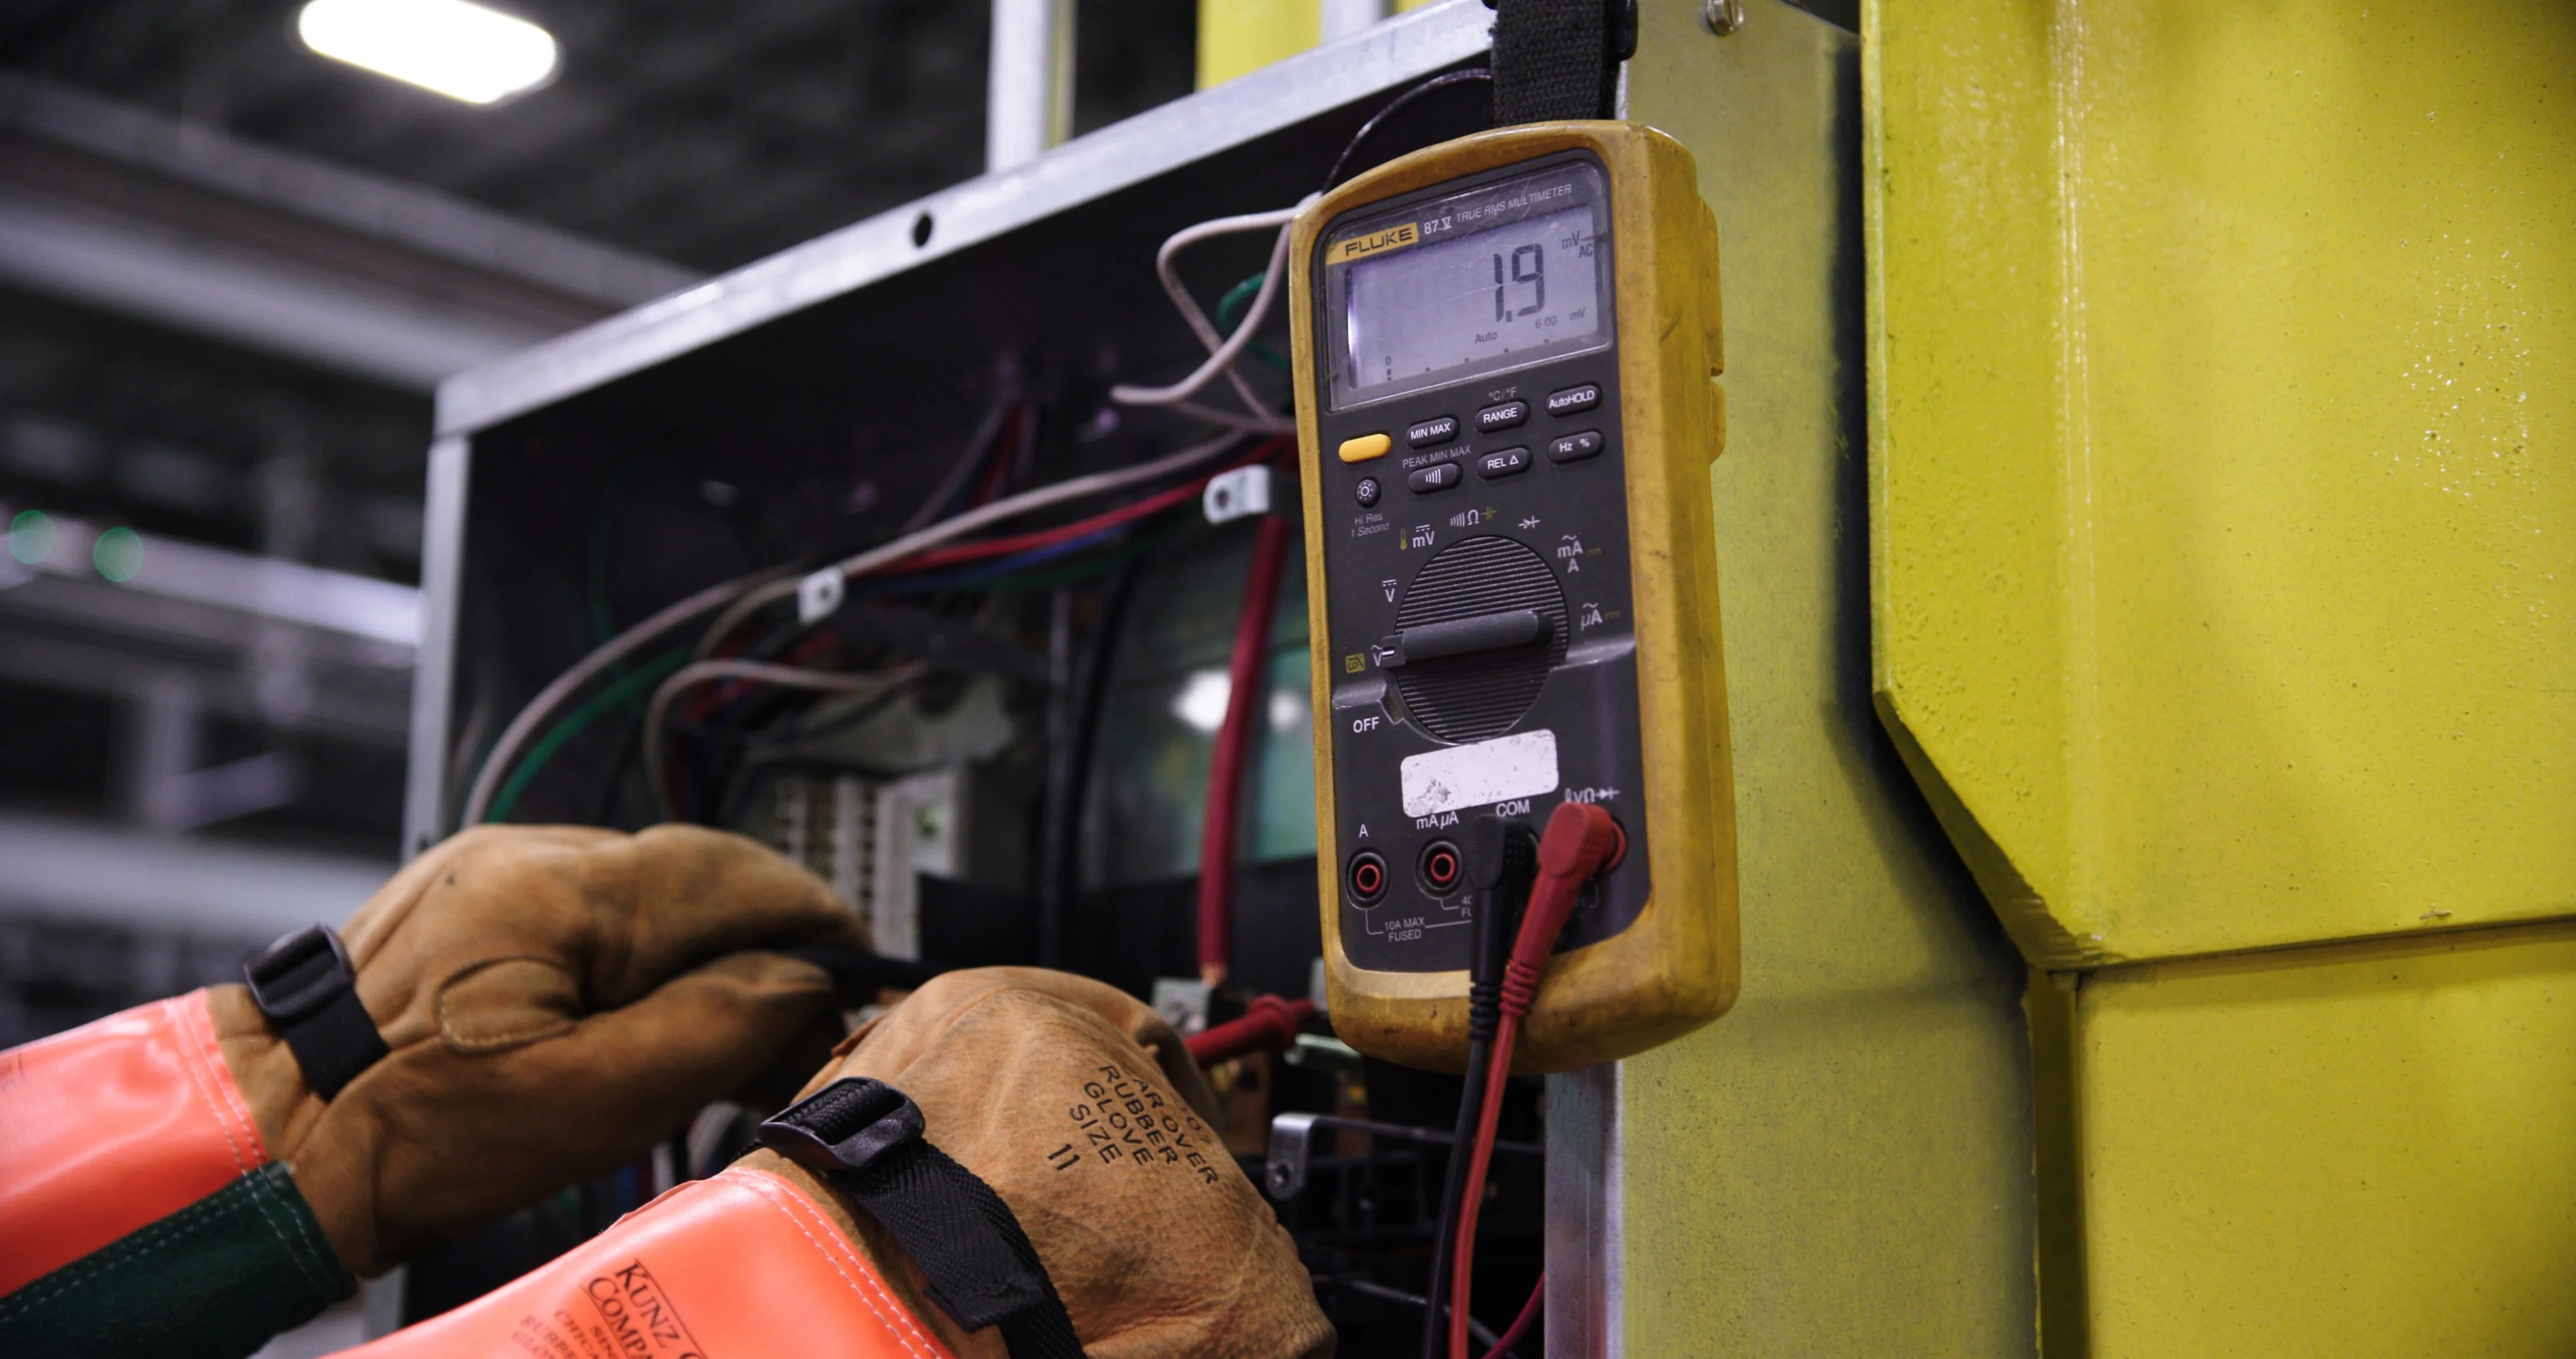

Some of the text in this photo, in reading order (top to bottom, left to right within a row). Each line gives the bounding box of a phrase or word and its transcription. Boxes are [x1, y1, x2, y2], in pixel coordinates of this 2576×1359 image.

[1424, 219, 1439, 235] 87
[1456, 208, 1482, 223] TRUE
[1484, 201, 1506, 215] RMS
[1508, 184, 1572, 209] MULTIMETER
[1345, 227, 1413, 257] FLUKE
[1561, 229, 1581, 248] mV
[1578, 243, 1593, 259] AC
[1493, 242, 1545, 322] 1.9
[1569, 308, 1586, 321] mV
[1474, 331, 1498, 344] Auto
[1548, 390, 1596, 409] AutoHOLD
[1483, 407, 1518, 424] RANGE
[1410, 422, 1451, 440] MIN MAX
[1559, 438, 1590, 453] Hz %
[1402, 445, 1472, 469] PEAK MIN MAX
[1487, 458, 1507, 470] REL
[1354, 512, 1383, 525] Hi Res
[1358, 522, 1390, 537] Second
[1412, 530, 1436, 548] mV
[1557, 542, 1584, 559] mA
[1567, 558, 1579, 573] A
[1384, 588, 1395, 603] V
[1353, 717, 1380, 734] OFF
[1495, 799, 1530, 817] COM
[1416, 814, 1439, 830] mA
[1358, 824, 1369, 838] A
[1384, 916, 1426, 932] 10A MAX
[1388, 929, 1422, 943] FUSED
[1099, 1064, 1178, 1165] RUBBER
[1083, 1081, 1155, 1166] GLOVE
[1069, 1103, 1124, 1165] SIZE
[1047, 1143, 1081, 1172] 11
[1160, 1114, 1220, 1185] OVER
[614, 1261, 680, 1349] KUNZ
